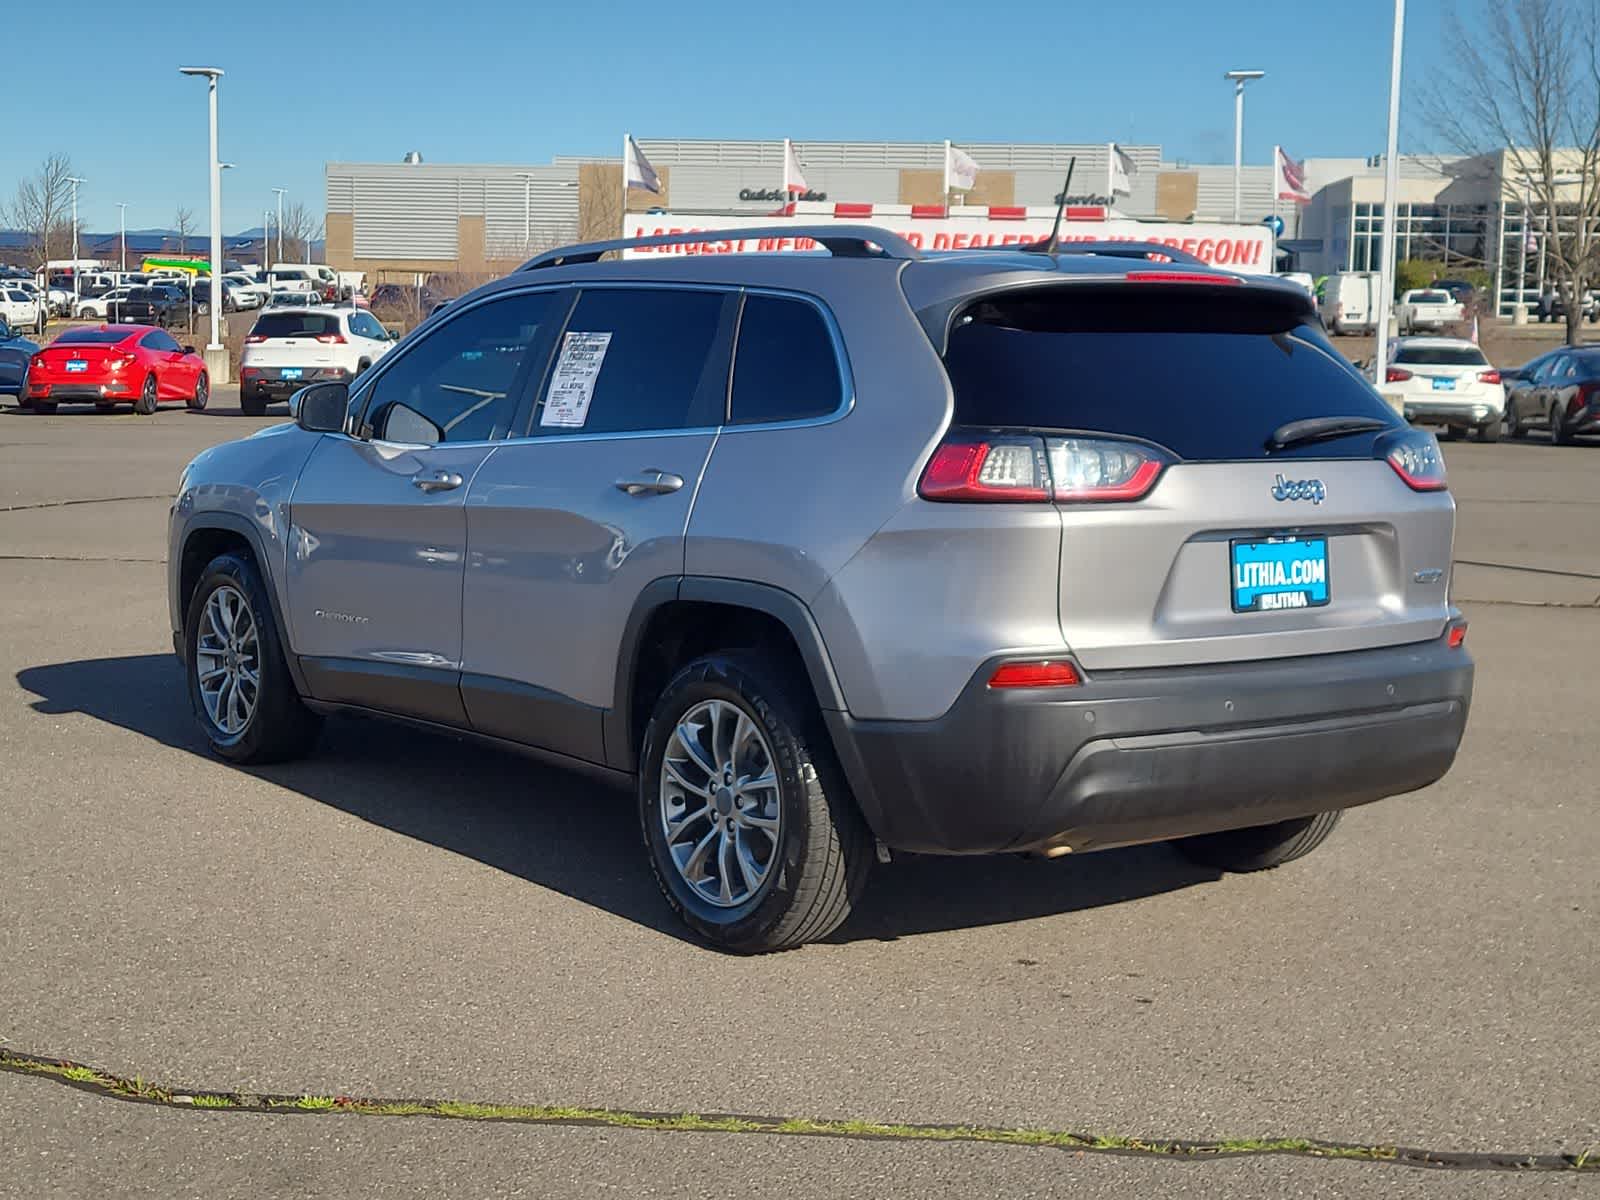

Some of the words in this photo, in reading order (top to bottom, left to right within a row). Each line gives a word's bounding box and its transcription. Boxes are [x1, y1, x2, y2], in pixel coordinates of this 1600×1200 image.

[1271, 474, 1327, 505] Jeep
[1236, 558, 1326, 588] LITHIA.COM
[1272, 591, 1308, 609] LITHIA
